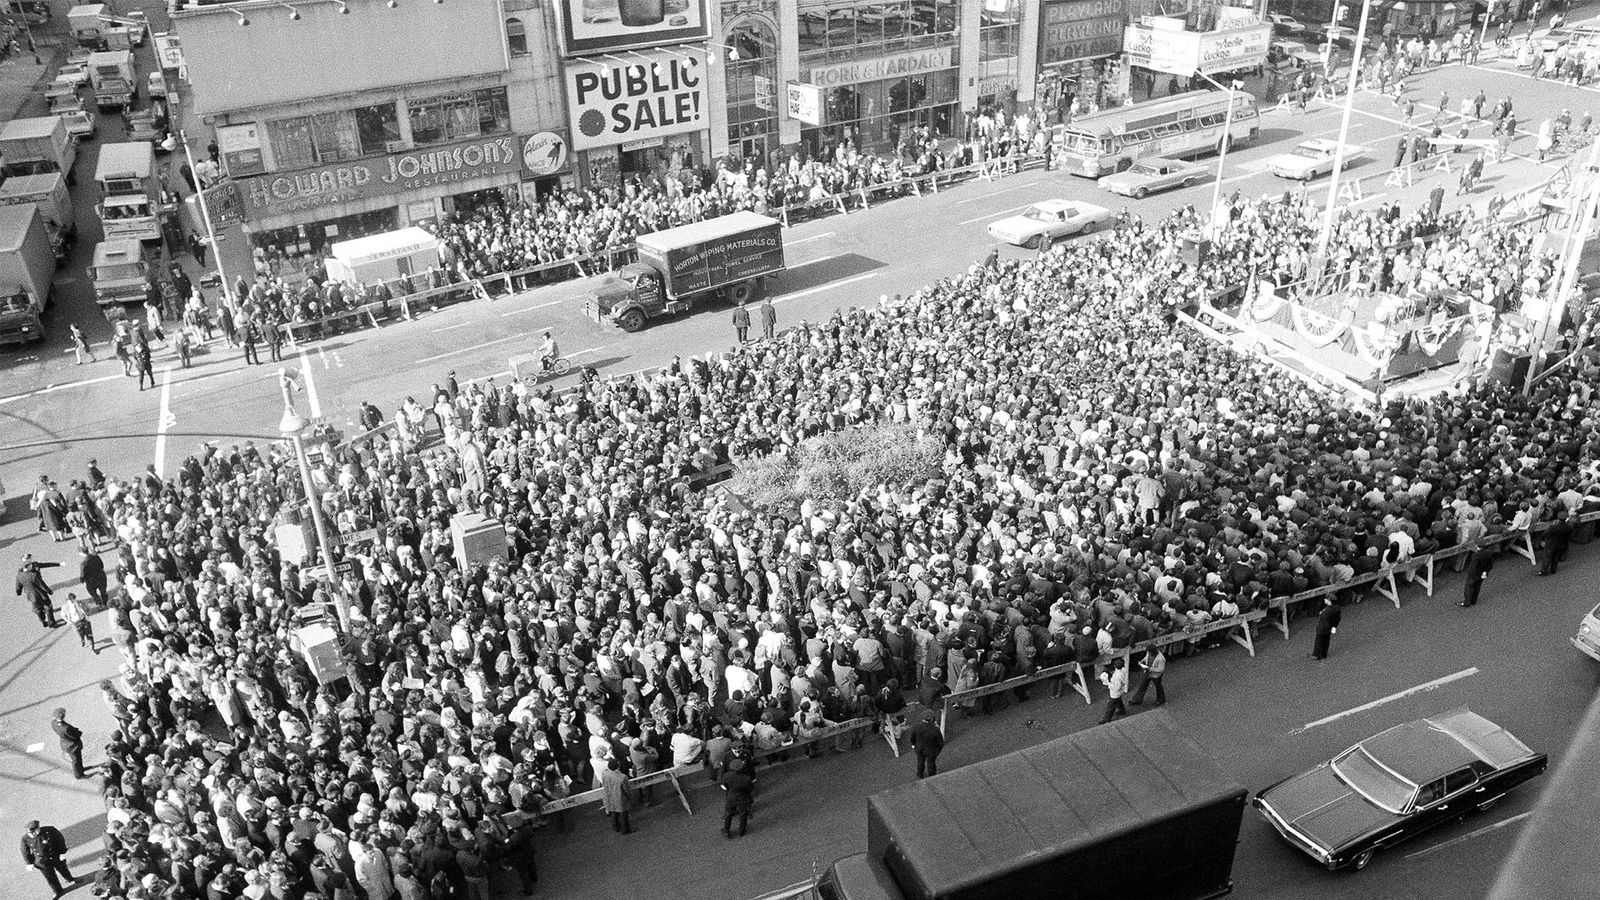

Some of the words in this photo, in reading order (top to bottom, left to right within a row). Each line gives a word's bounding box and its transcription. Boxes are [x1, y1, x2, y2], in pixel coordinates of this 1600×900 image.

[1048, 19, 1120, 41] PLAYLAND
[575, 56, 700, 105] PUBLIC
[815, 64, 859, 85] HORN
[875, 51, 945, 75] HARDART
[611, 90, 700, 134] SALE!
[249, 165, 371, 208] HOWARD
[382, 137, 514, 183] JOHNSON'S
[277, 192, 365, 211] COCKTAILS
[404, 166, 497, 189] RESTAURANT
[674, 255, 699, 272] HORTON
[699, 245, 726, 259] WIPING
[726, 238, 766, 250] MATERIALS
[742, 254, 763, 264] SERVICE
[688, 281, 707, 290] WASTE
[738, 264, 771, 276] CHEESECLOTH
